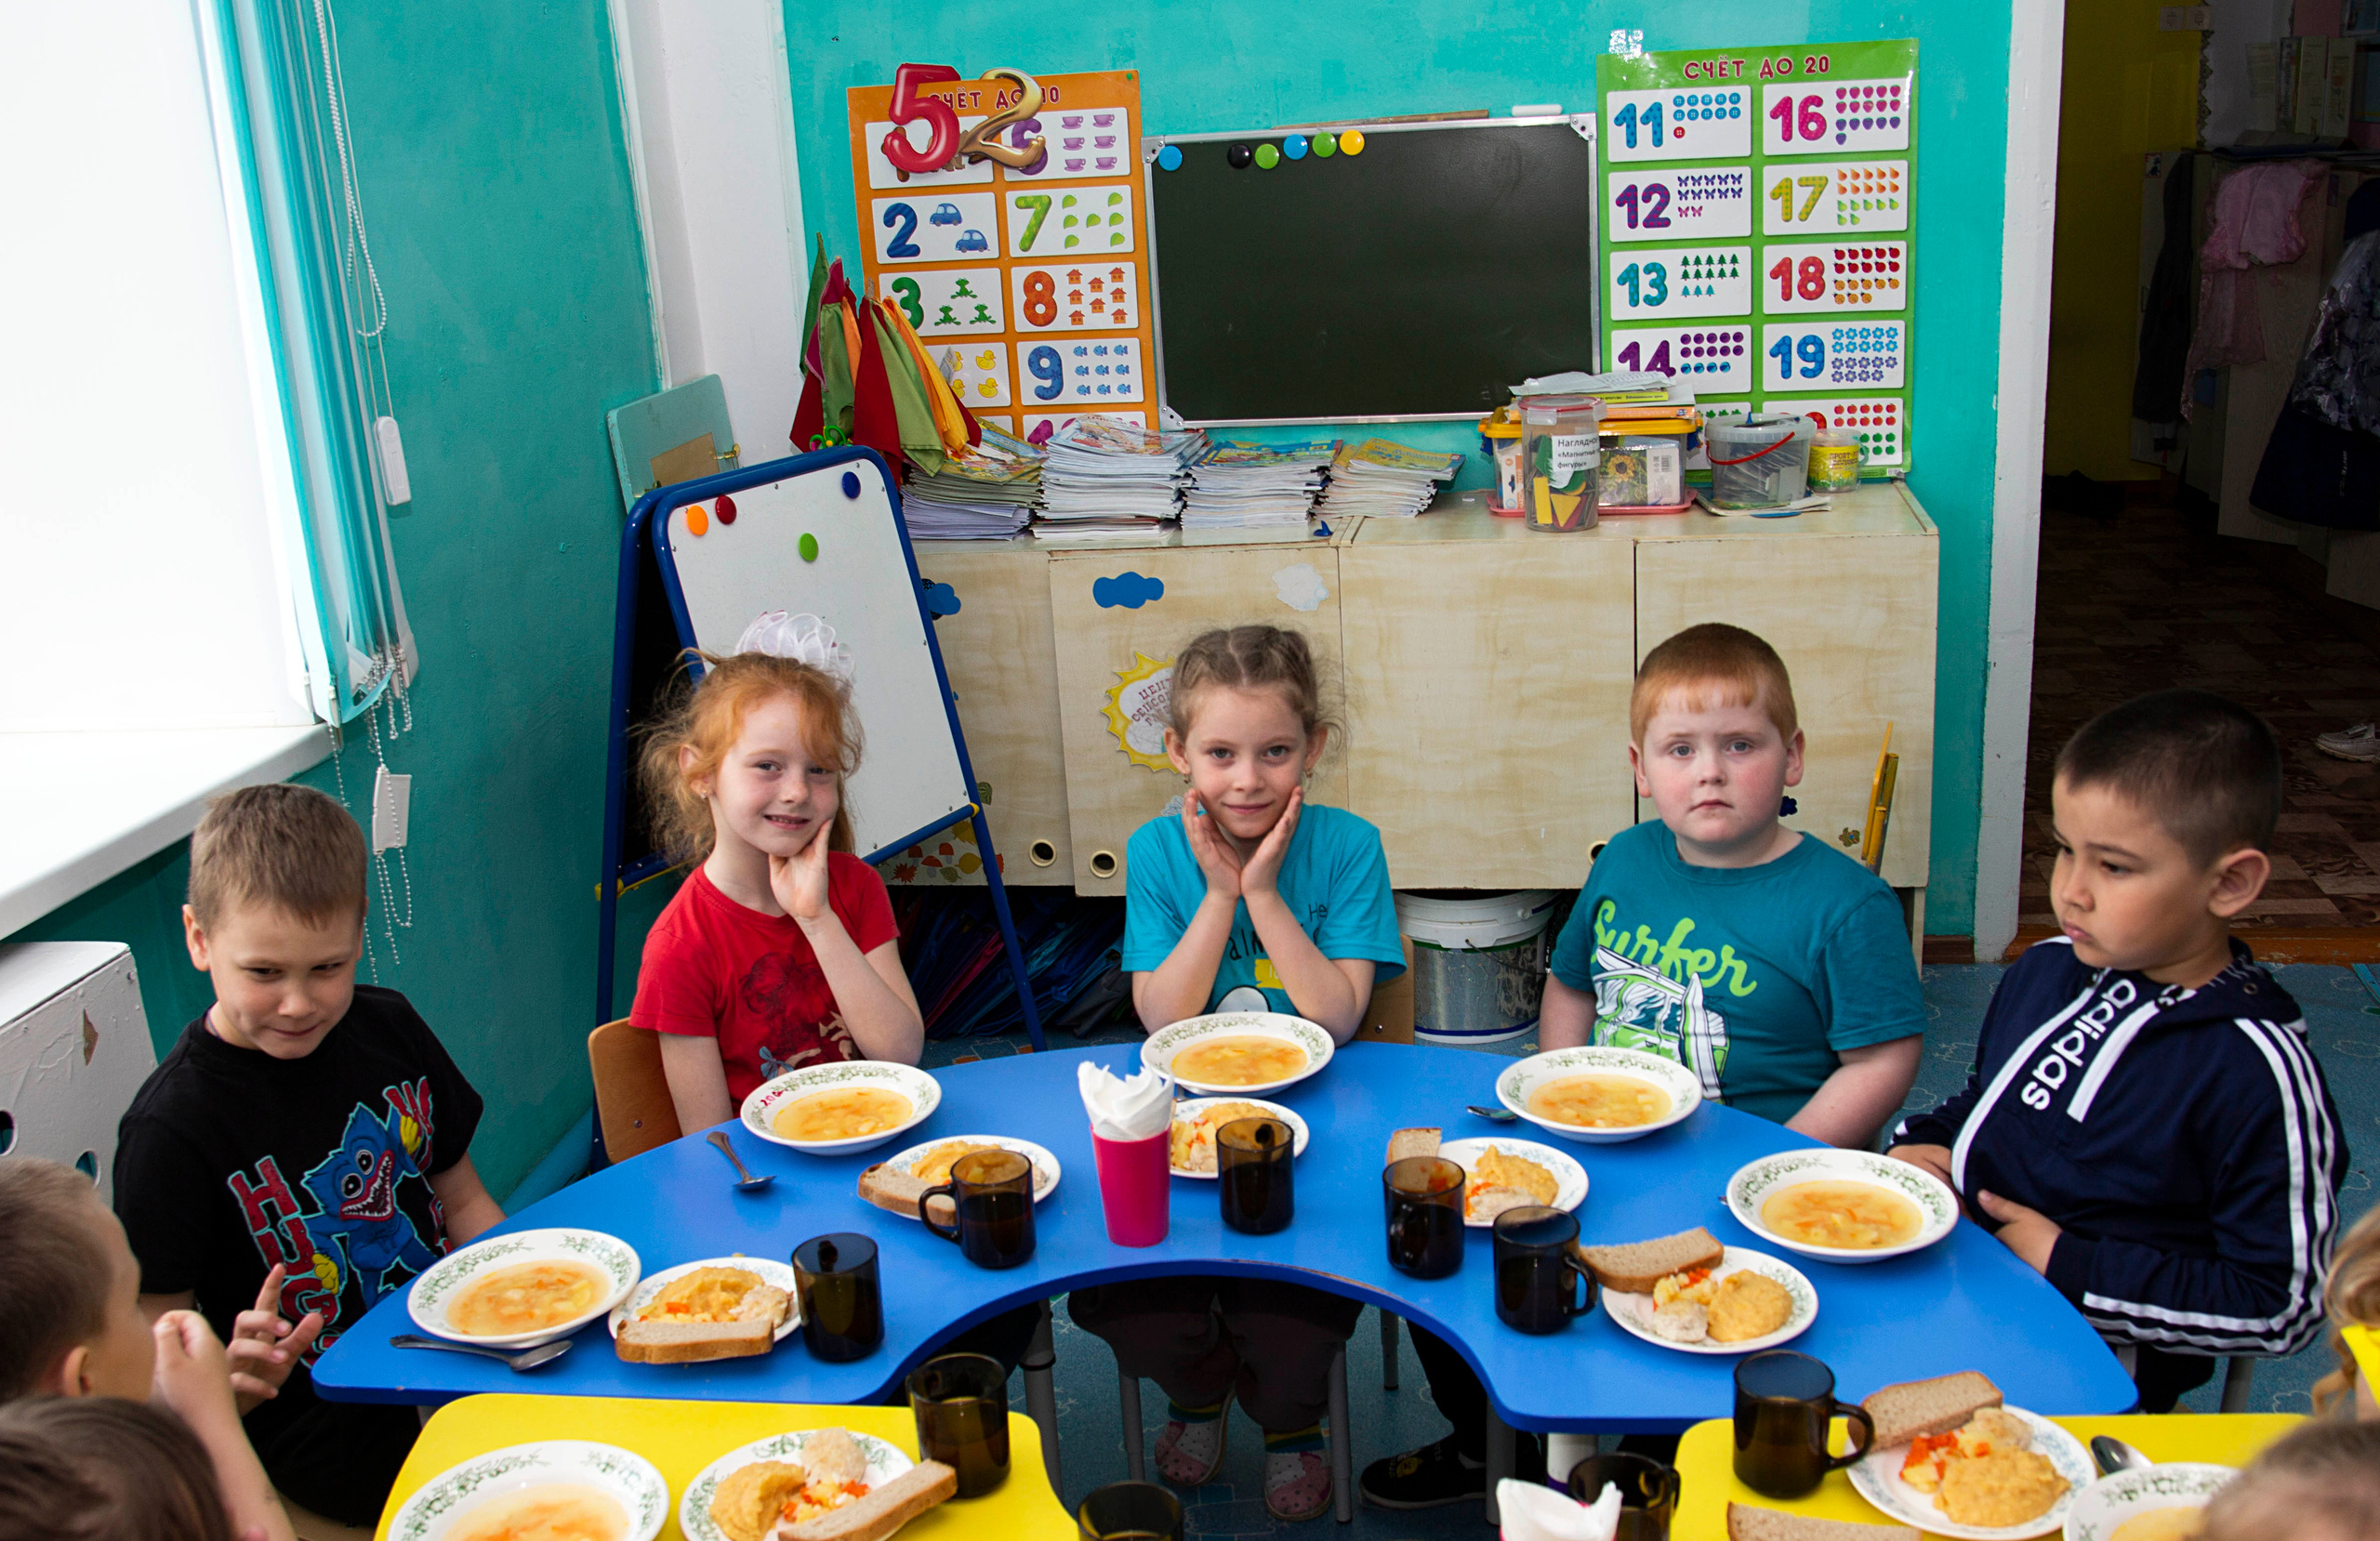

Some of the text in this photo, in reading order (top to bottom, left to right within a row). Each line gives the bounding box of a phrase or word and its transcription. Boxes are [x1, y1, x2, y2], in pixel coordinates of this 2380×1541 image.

[1684, 56, 1830, 80] СЧЁТ ДО 20
[889, 62, 961, 174] 5
[929, 87, 982, 111] ЧЁТ
[1769, 95, 1828, 142] 16
[1614, 102, 1663, 149] 11
[1616, 183, 1672, 230] 12
[1770, 175, 1829, 222] 17
[883, 203, 920, 258] 2
[1014, 194, 1052, 253] 7
[1023, 270, 1058, 327] 8
[1617, 262, 1669, 308] 13
[1769, 256, 1826, 301] 18
[891, 276, 924, 332] 3
[1027, 345, 1064, 402] 9
[1618, 339, 1677, 378] 14
[1769, 334, 1826, 379] 19
[1590, 900, 1758, 997] Surfer
[2020, 978, 2137, 1111] adidas
